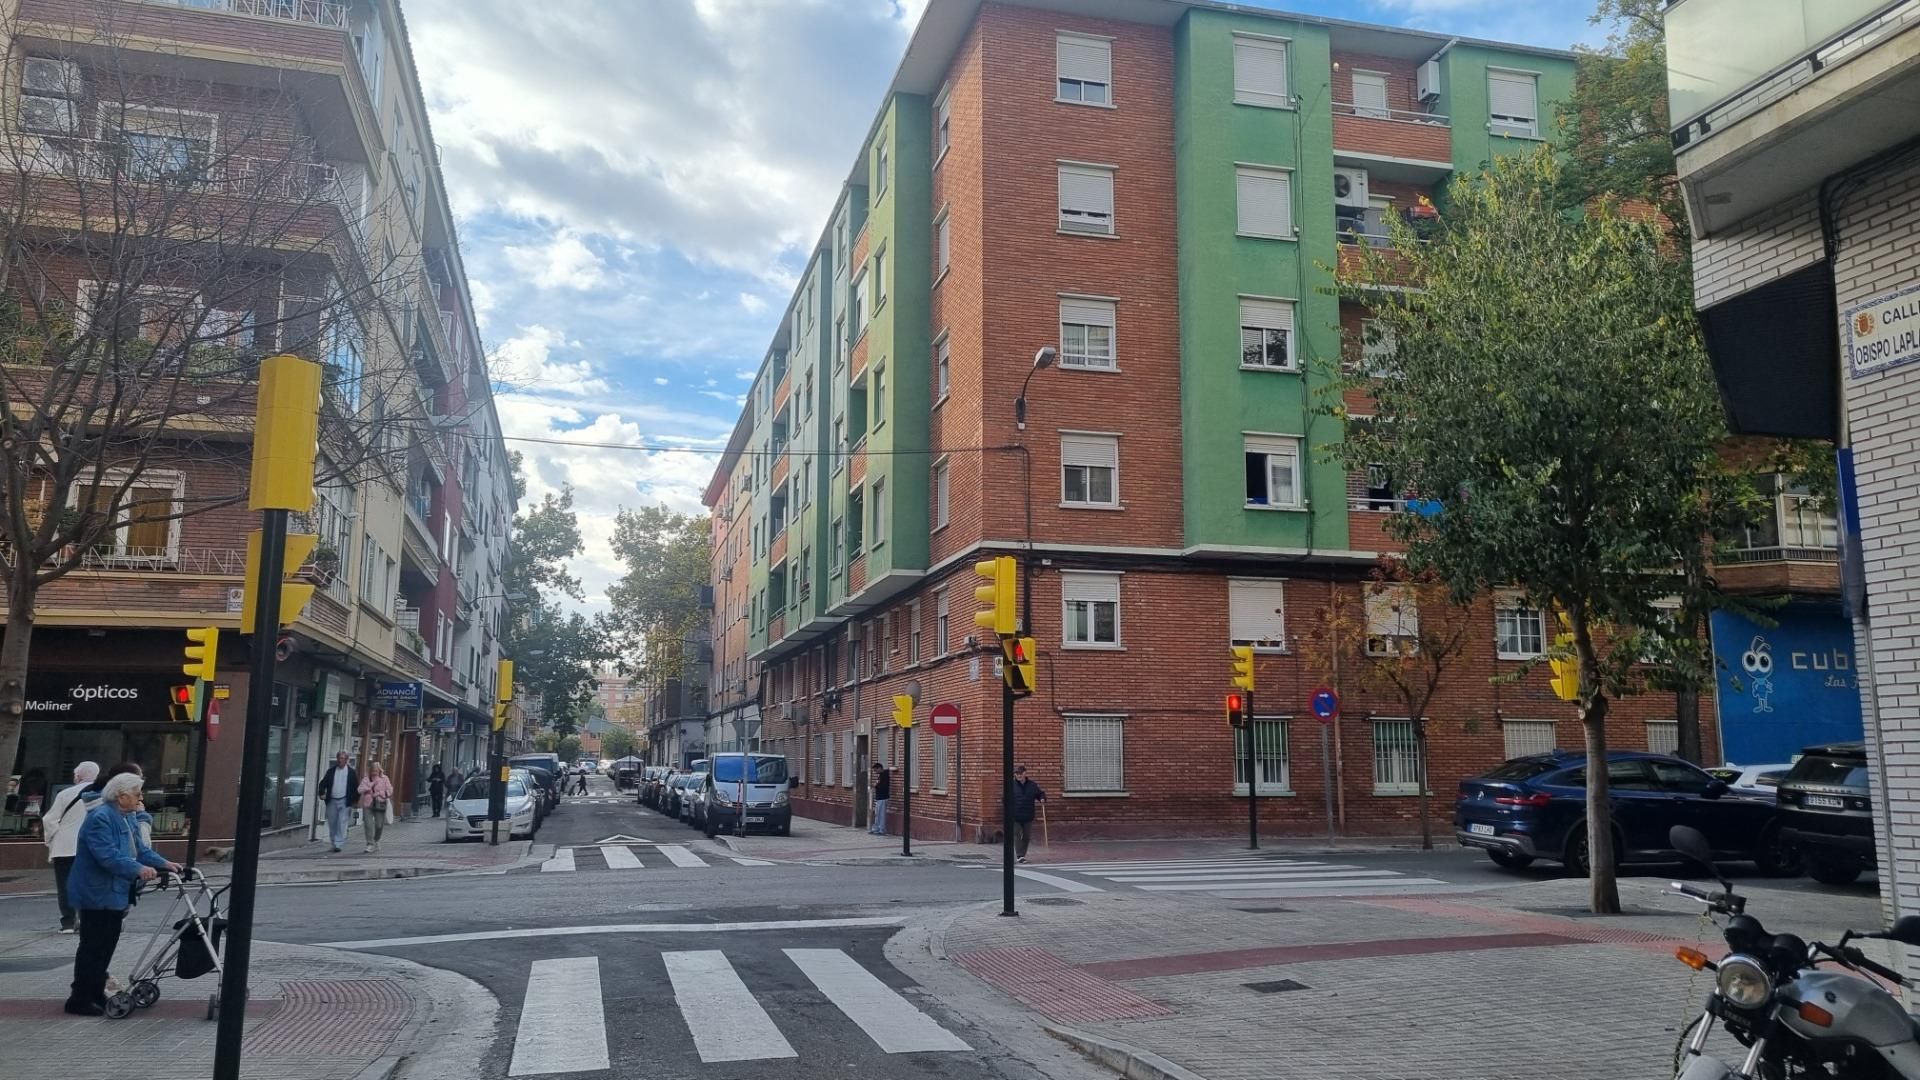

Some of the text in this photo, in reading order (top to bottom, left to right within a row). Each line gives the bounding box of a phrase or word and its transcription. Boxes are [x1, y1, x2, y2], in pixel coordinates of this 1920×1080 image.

[1856, 339, 1890, 365] OBISPO
[376, 688, 416, 696] ADVANCE
[25, 701, 73, 711] Moliner
